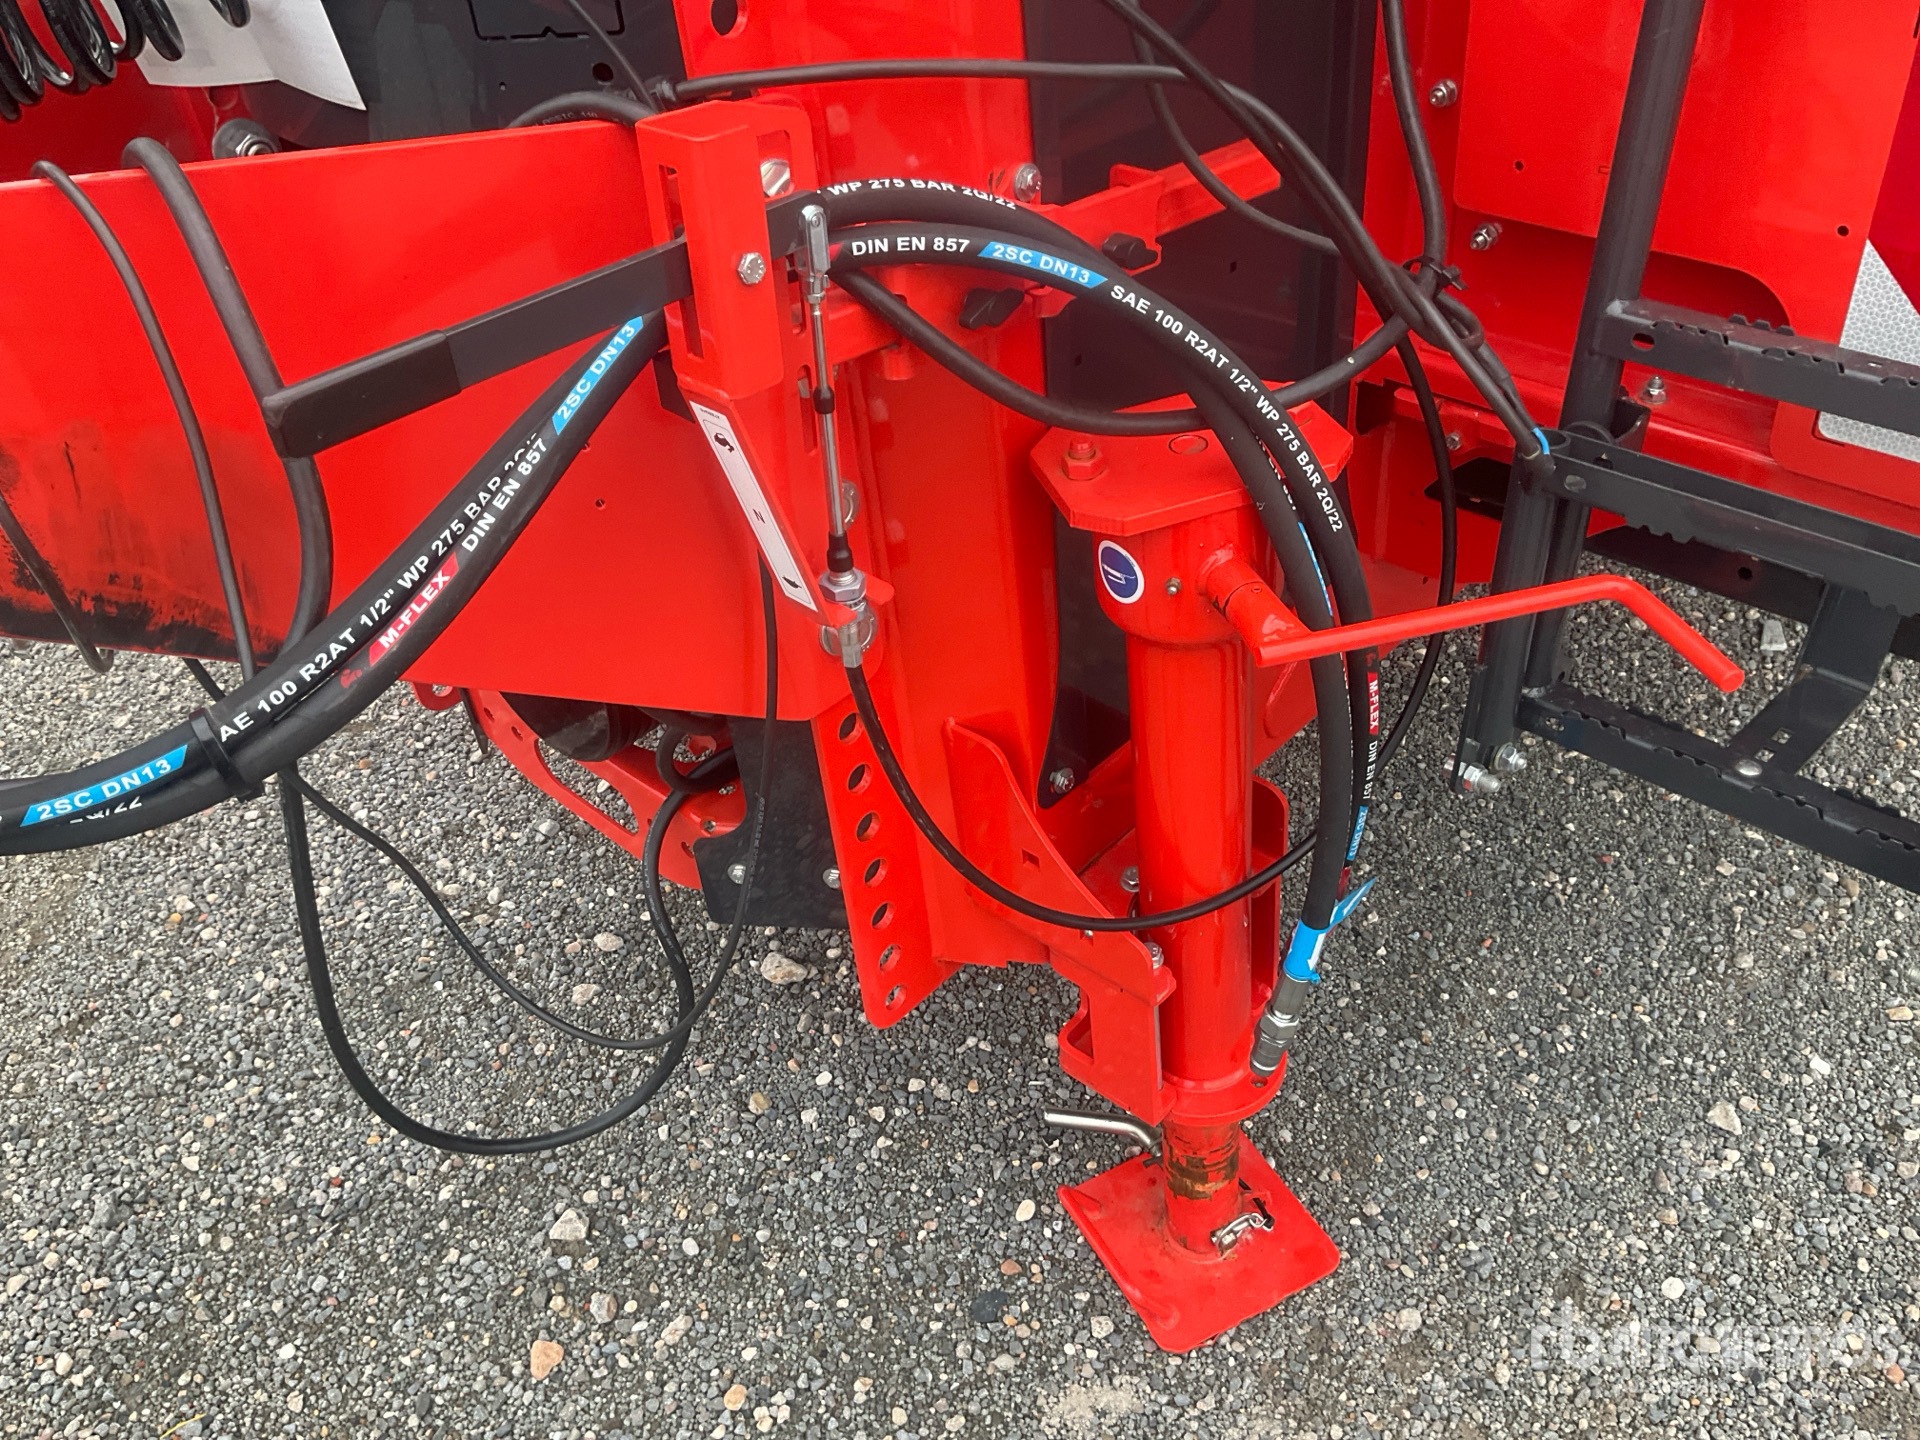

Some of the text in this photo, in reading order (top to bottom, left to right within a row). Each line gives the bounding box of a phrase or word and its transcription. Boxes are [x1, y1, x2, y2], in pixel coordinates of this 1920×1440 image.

[827, 181, 862, 196] WP
[868, 179, 906, 190] 275
[910, 179, 956, 193] BAR
[851, 236, 1343, 532] DIN EN 857 2SC DN13 SAE 100 R2AT 1/2" WP 275 BAR 2Q/22
[378, 569, 450, 649] M-FLEX
[461, 512, 496, 552] DIN
[492, 478, 521, 510] EN
[517, 437, 547, 475] 857
[557, 378, 591, 420] 2SC
[590, 324, 635, 376] DN13
[36, 476, 501, 820] 2SC DN13 AE 100 R2AT 1/2" WP 275 BAR
[1369, 679, 1379, 729] M-FLEX
[1366, 763, 1376, 780] EN
[1368, 741, 1378, 762] DIN
